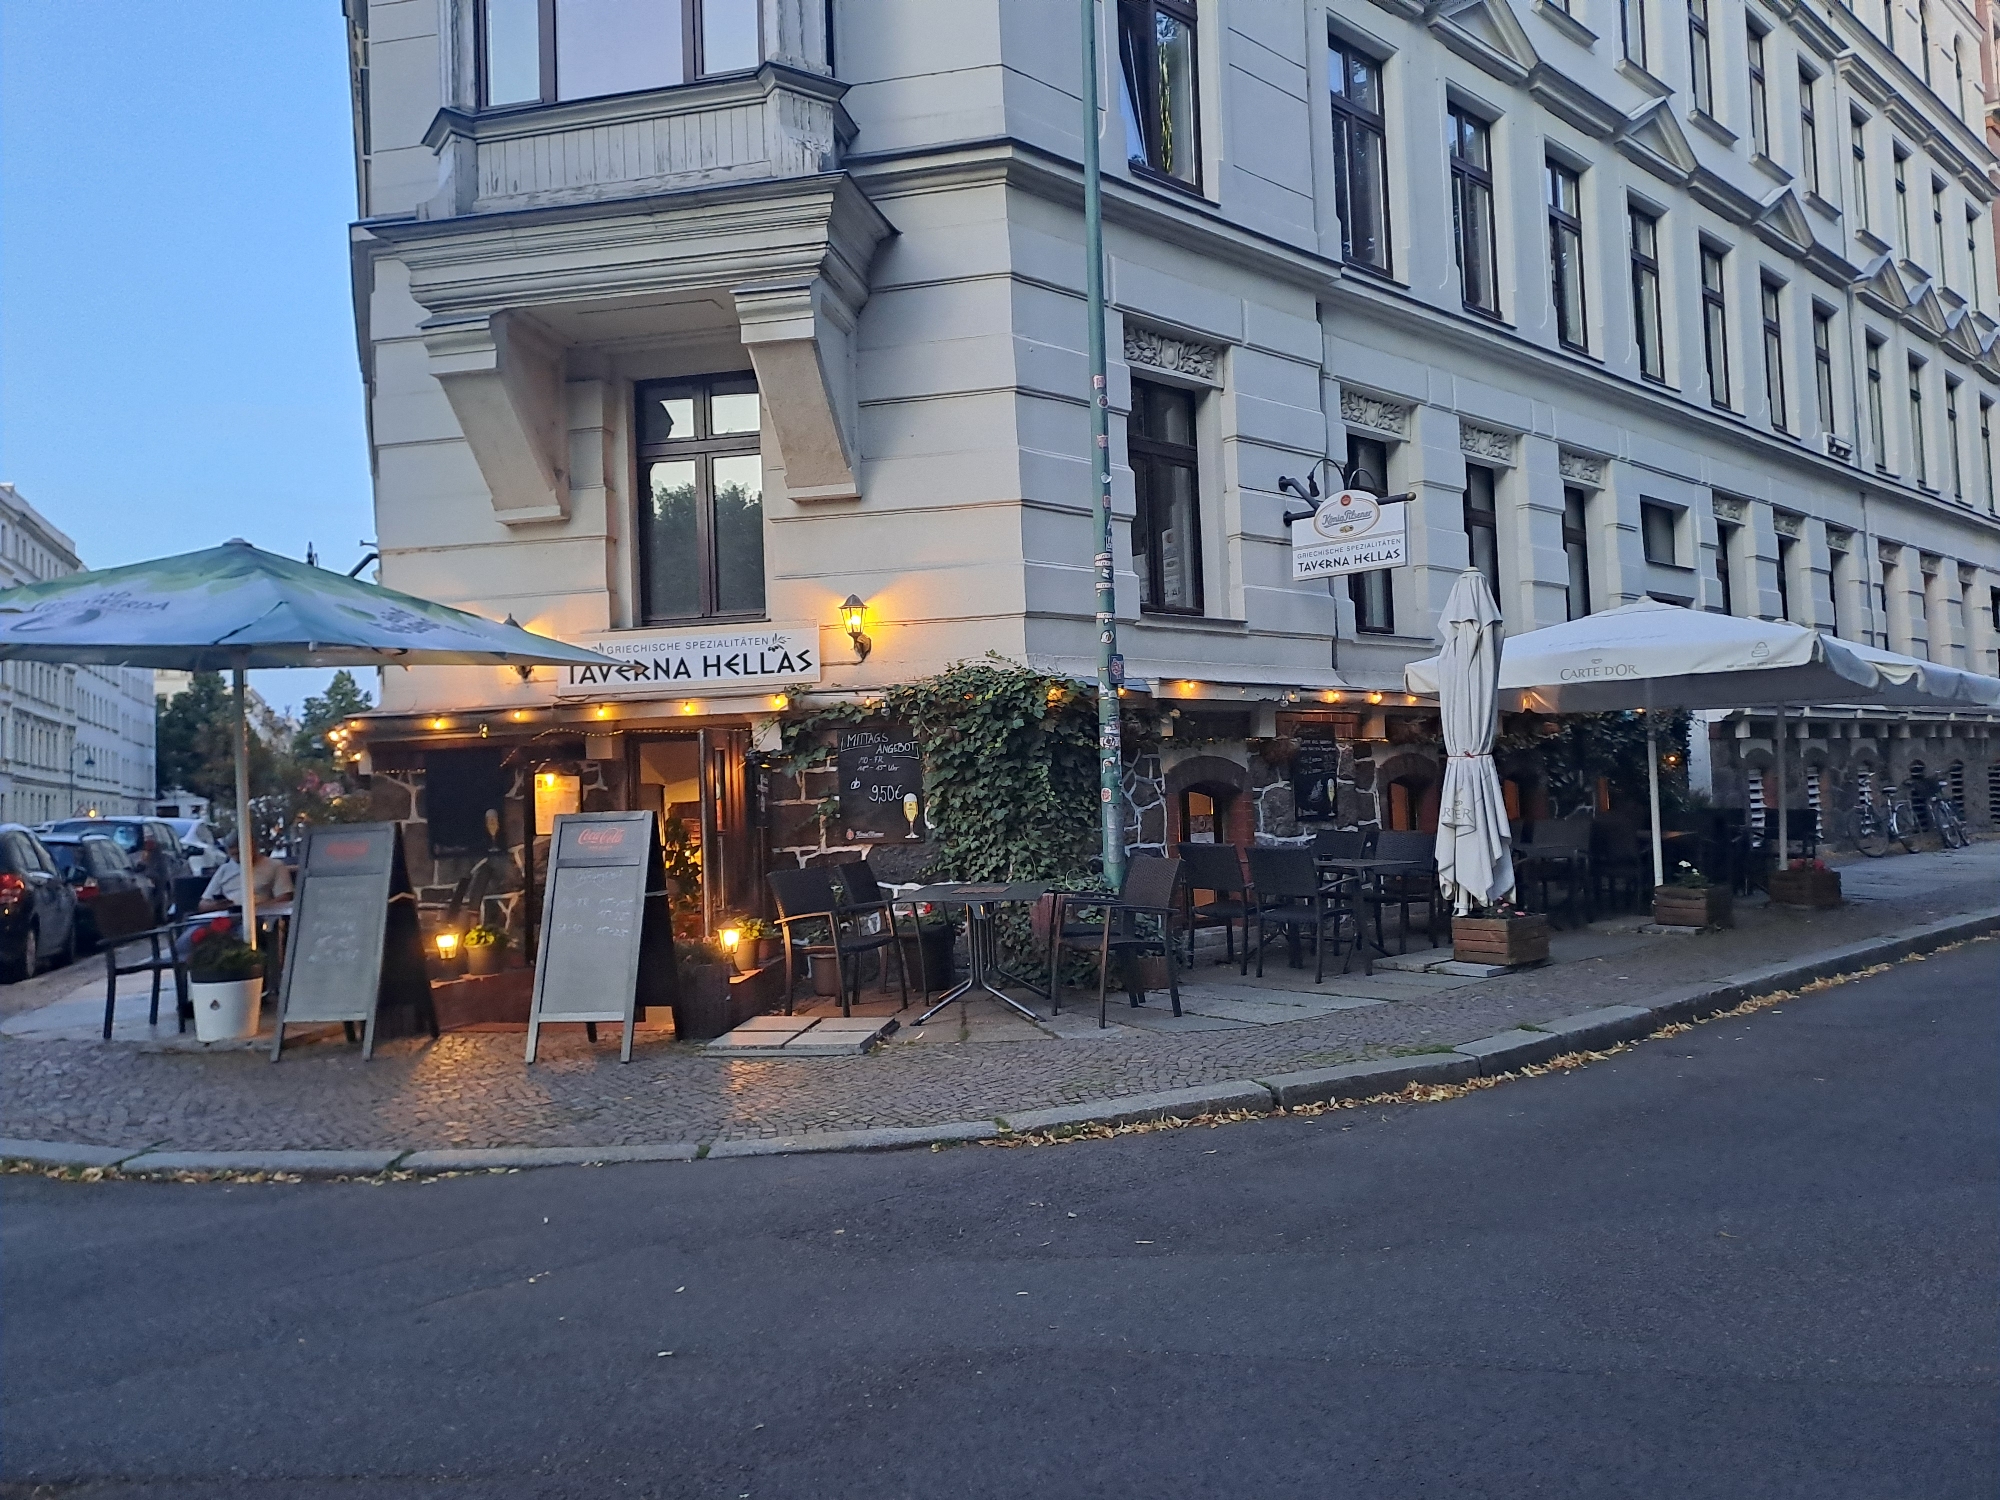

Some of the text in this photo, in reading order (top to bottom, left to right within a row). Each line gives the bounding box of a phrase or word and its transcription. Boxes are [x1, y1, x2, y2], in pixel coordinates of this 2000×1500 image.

[1297, 538, 1401, 559] GRIECHISCHE SPEZIALITÄTEN
[1298, 548, 1401, 572] TAVERNA HELLAS
[606, 637, 769, 655] GRIECHISCHE SPEZIALITÄTEN
[570, 649, 813, 685] TAVERNA HELLAS
[1560, 667, 1600, 680] CARTE
[847, 732, 889, 747] MITTAGS
[875, 741, 919, 754] ANGEBOT
